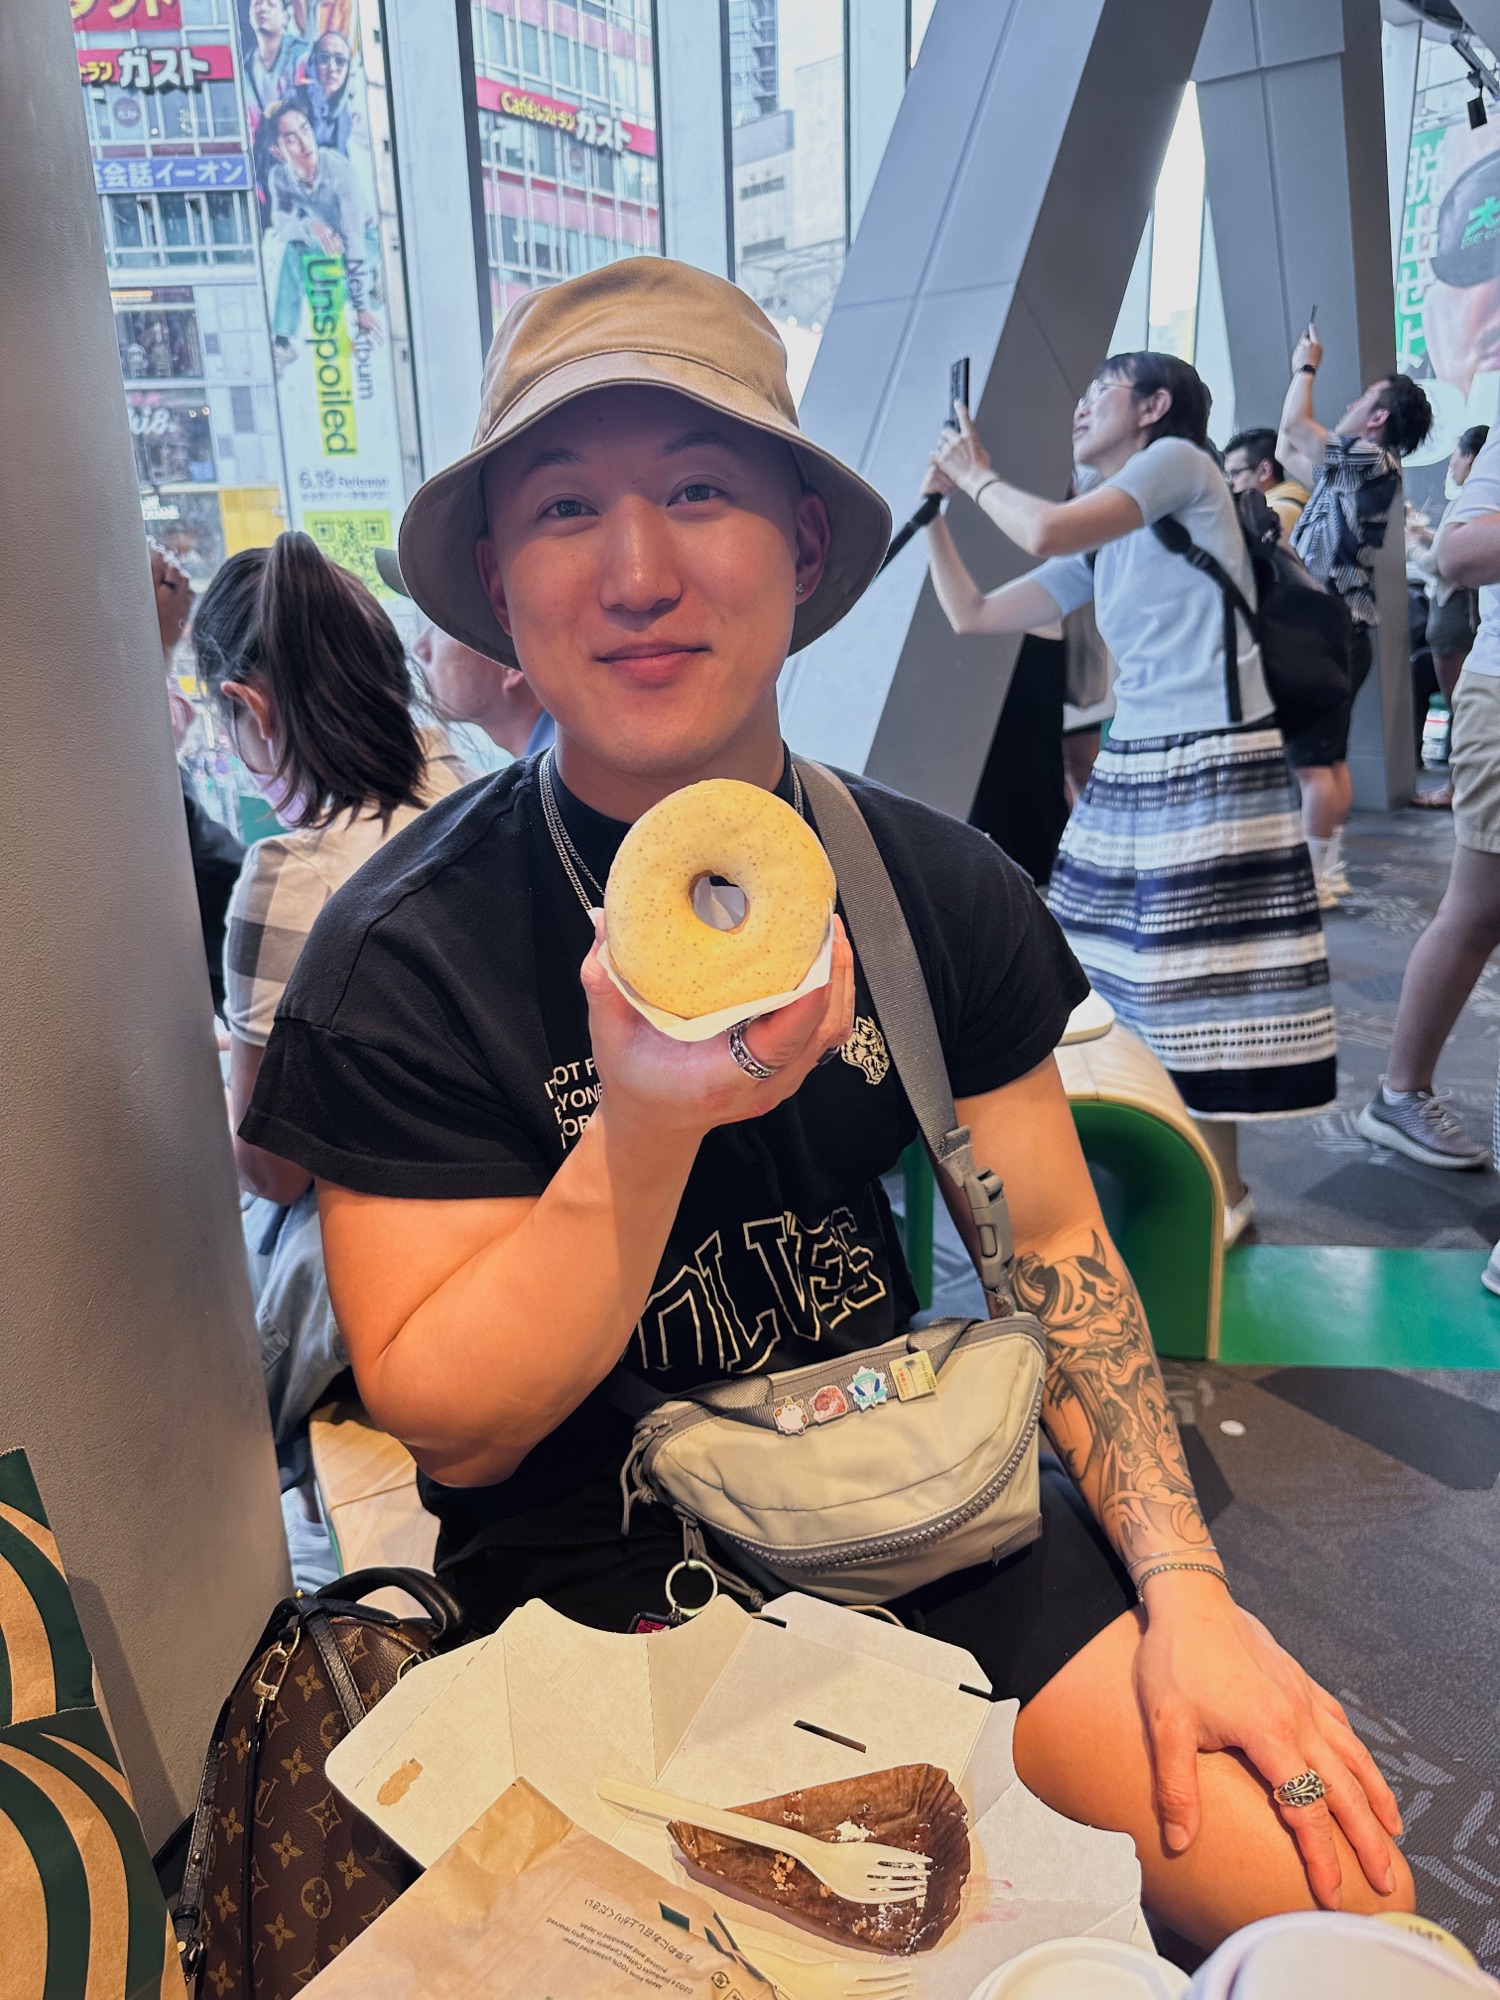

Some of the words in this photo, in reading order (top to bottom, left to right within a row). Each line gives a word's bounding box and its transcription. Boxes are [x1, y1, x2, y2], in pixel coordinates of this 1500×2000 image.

[118, 48, 209, 88] ガスト
[575, 109, 633, 152] ガスト
[1397, 143, 1447, 369] 脱出せよ
[344, 258, 366, 313] New
[305, 258, 358, 456] Unspoiled
[351, 321, 376, 400] Album
[571, 1928, 589, 1943] rights
[584, 1898, 694, 1964] お早めにお召し上がりください
[602, 1933, 633, 1950] assembled
[611, 1959, 630, 1973] 100%
[621, 1953, 646, 1970] Coffee
[632, 1948, 646, 1960] and
[644, 1957, 669, 1973] Printed
